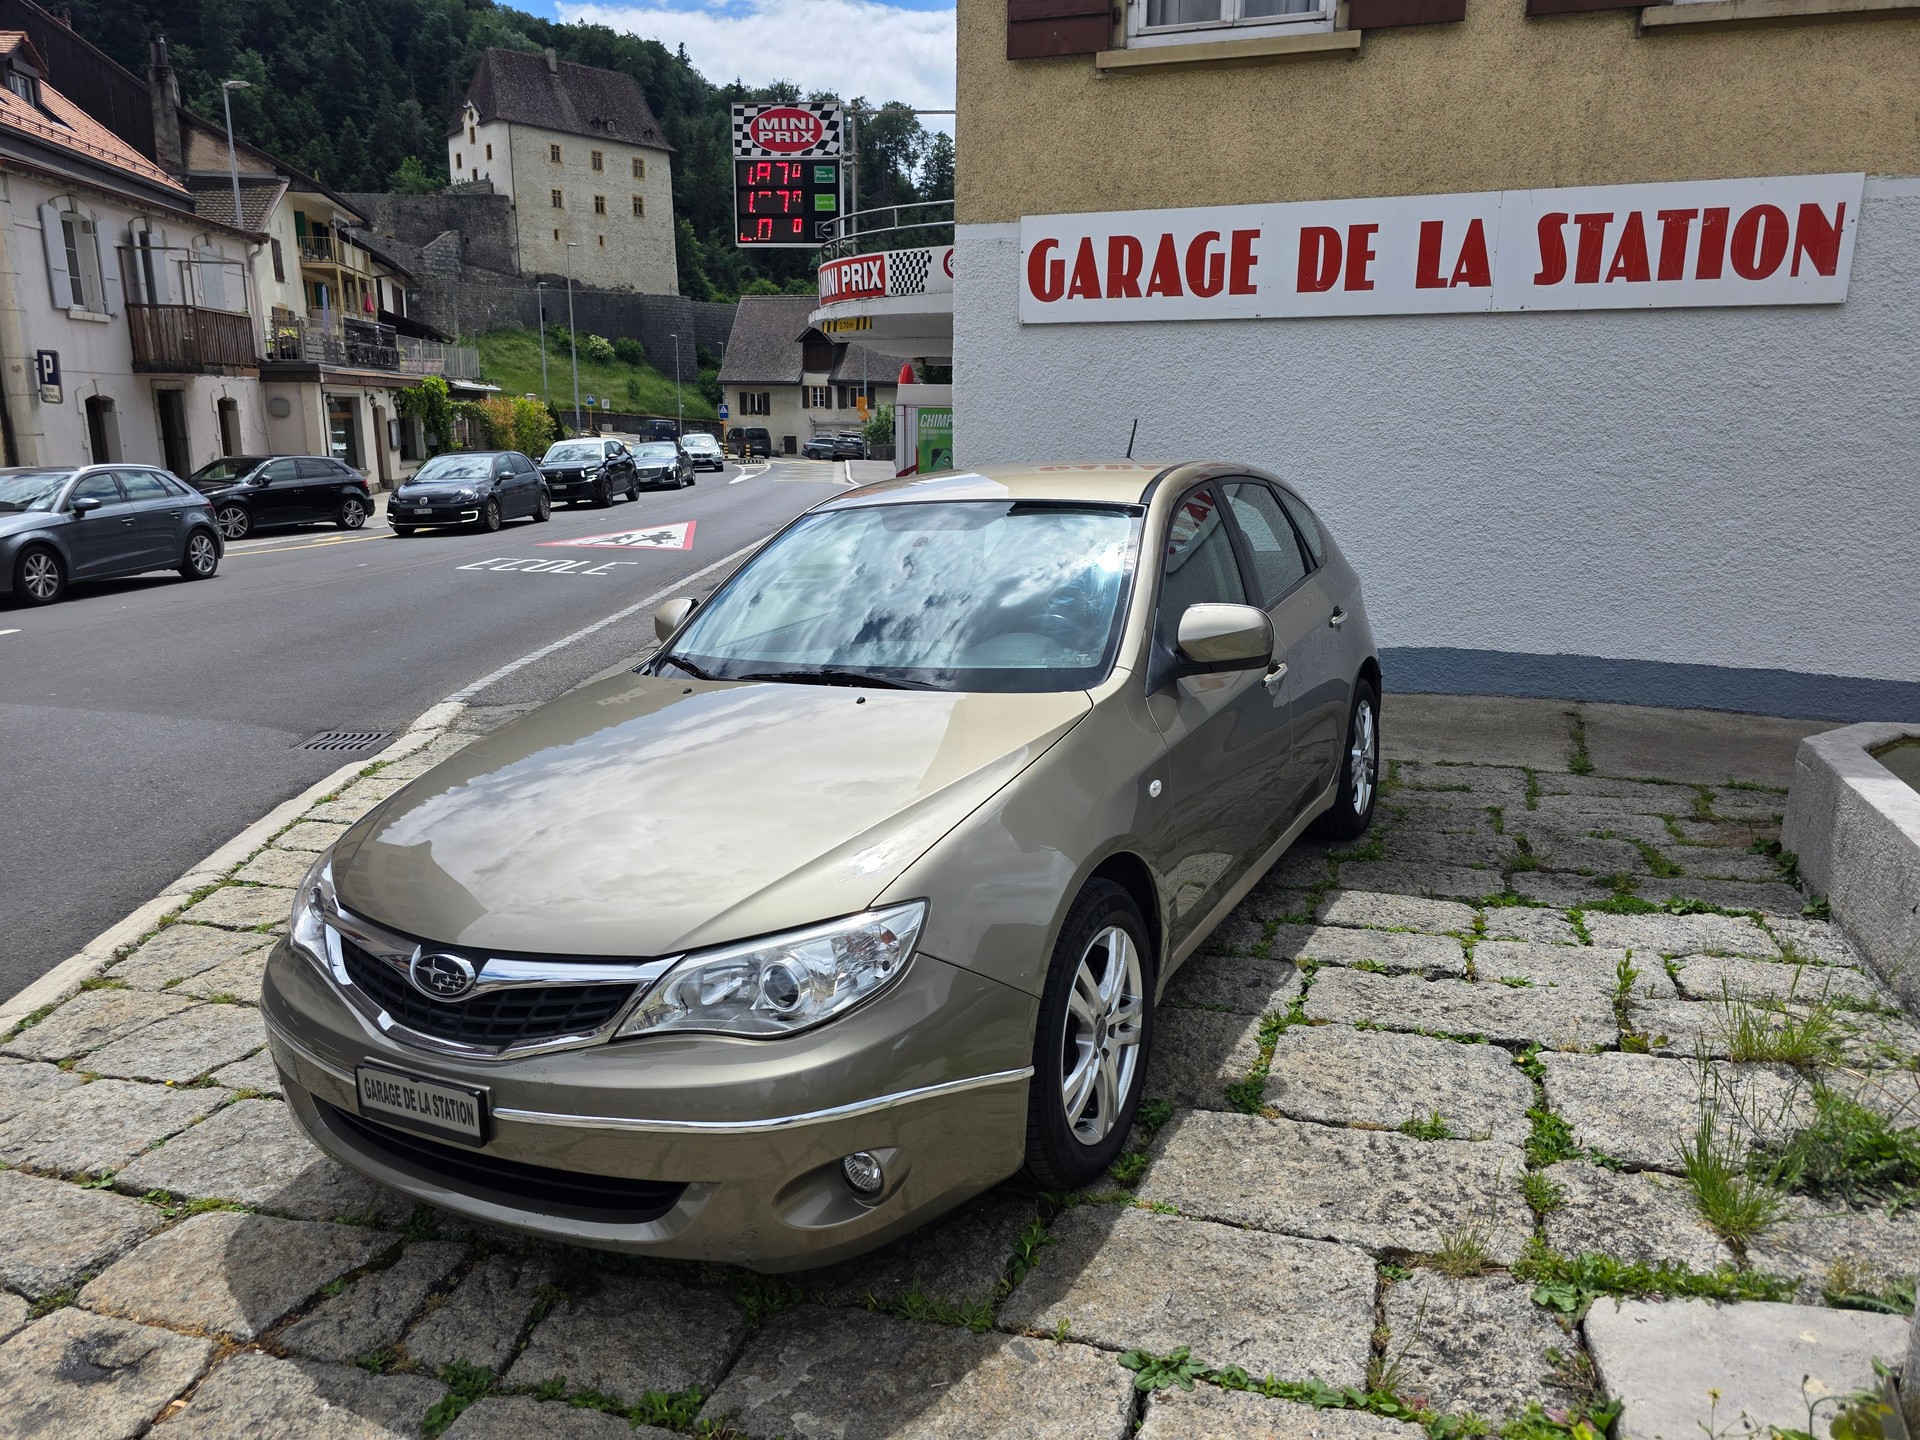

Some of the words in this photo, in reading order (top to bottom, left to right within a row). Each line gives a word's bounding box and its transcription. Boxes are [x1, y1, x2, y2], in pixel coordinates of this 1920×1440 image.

[758, 117, 815, 130] MINI
[758, 130, 816, 143] PRIX
[1027, 229, 1261, 303] GARAGE
[1296, 223, 1379, 293] DE
[1415, 218, 1492, 289] LA
[1533, 202, 1847, 286] STATION
[820, 267, 838, 298] MINI
[841, 260, 883, 293] PRIX
[42, 354, 54, 382] P
[454, 557, 639, 576] ECOLE
[364, 1077, 402, 1108] GARAGE
[403, 1086, 417, 1112] DE
[418, 1091, 432, 1116] LA
[433, 1094, 475, 1127] STATION
